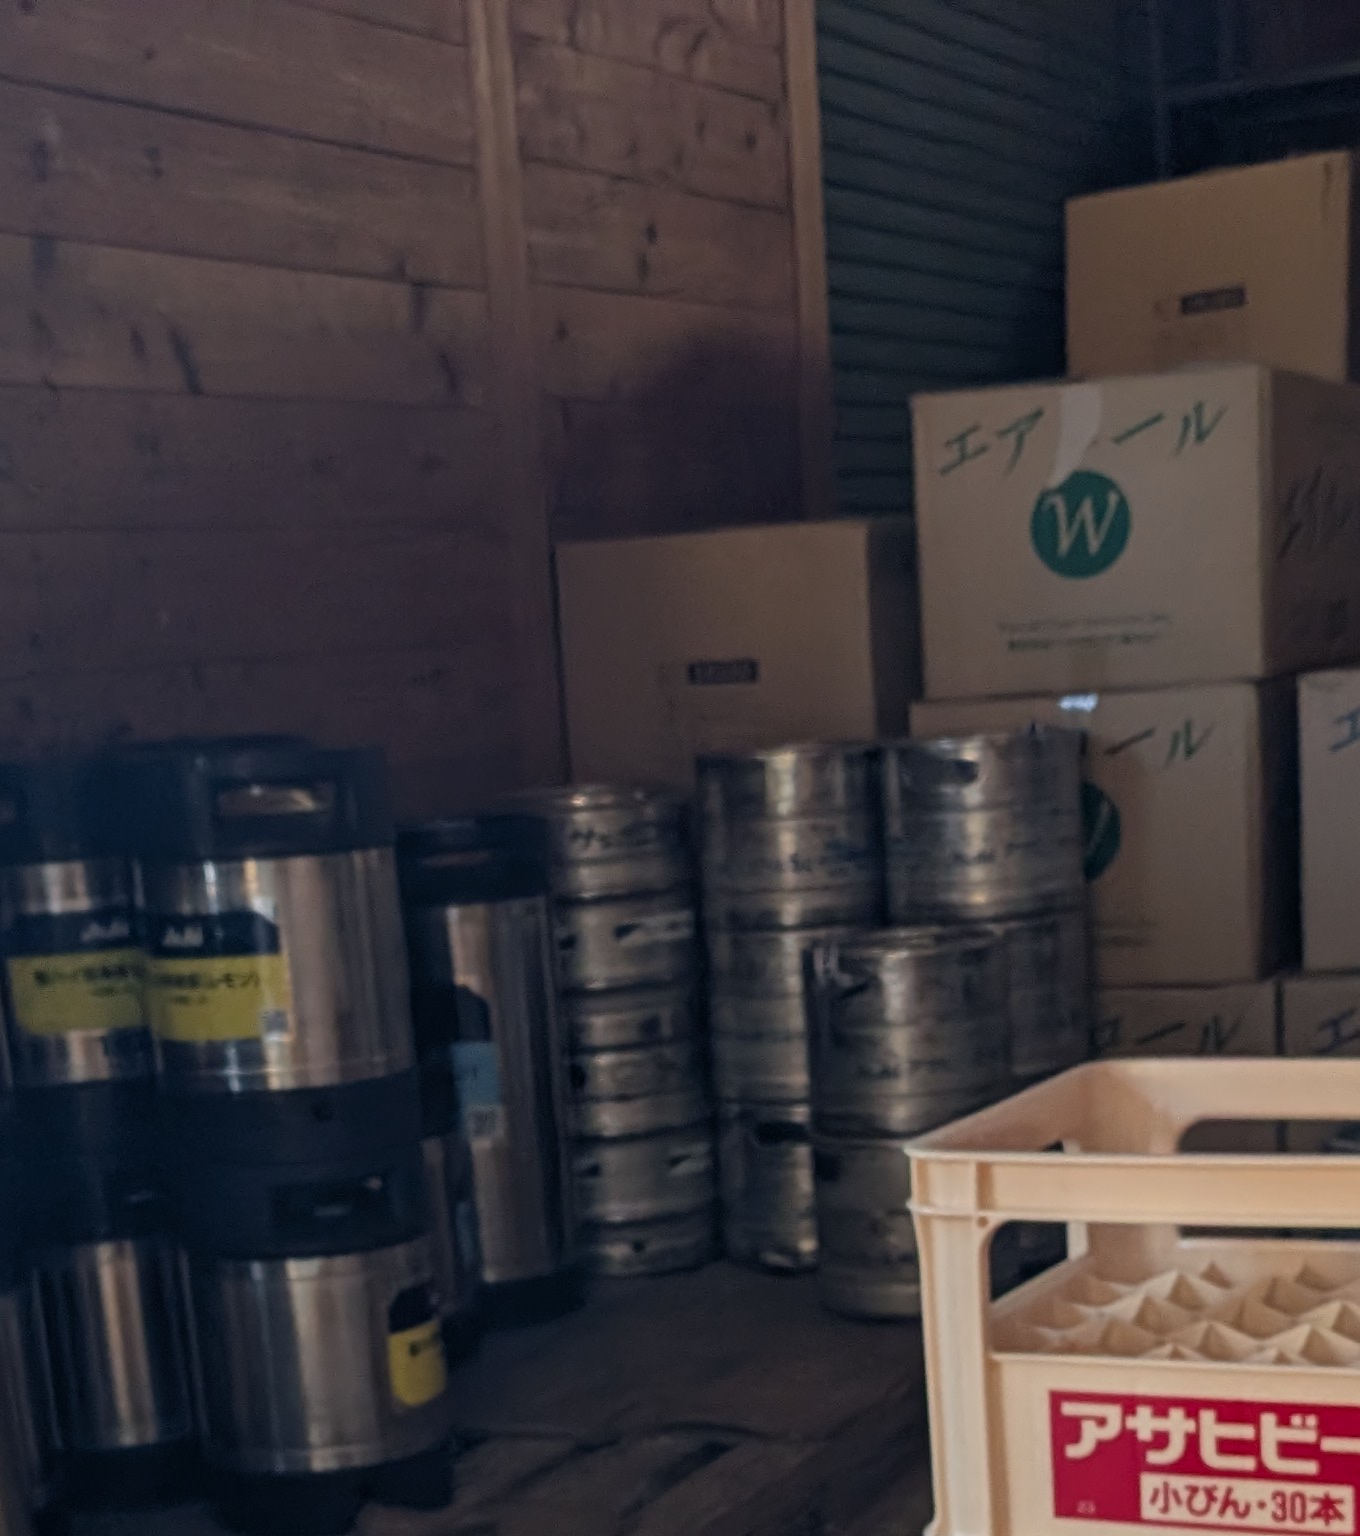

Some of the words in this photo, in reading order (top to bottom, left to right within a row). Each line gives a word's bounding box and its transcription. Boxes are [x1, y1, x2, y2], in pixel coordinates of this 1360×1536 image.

[939, 400, 1230, 476] エアール
[1041, 488, 1124, 558] W
[1148, 1481, 1346, 1527] 小びん・30本
